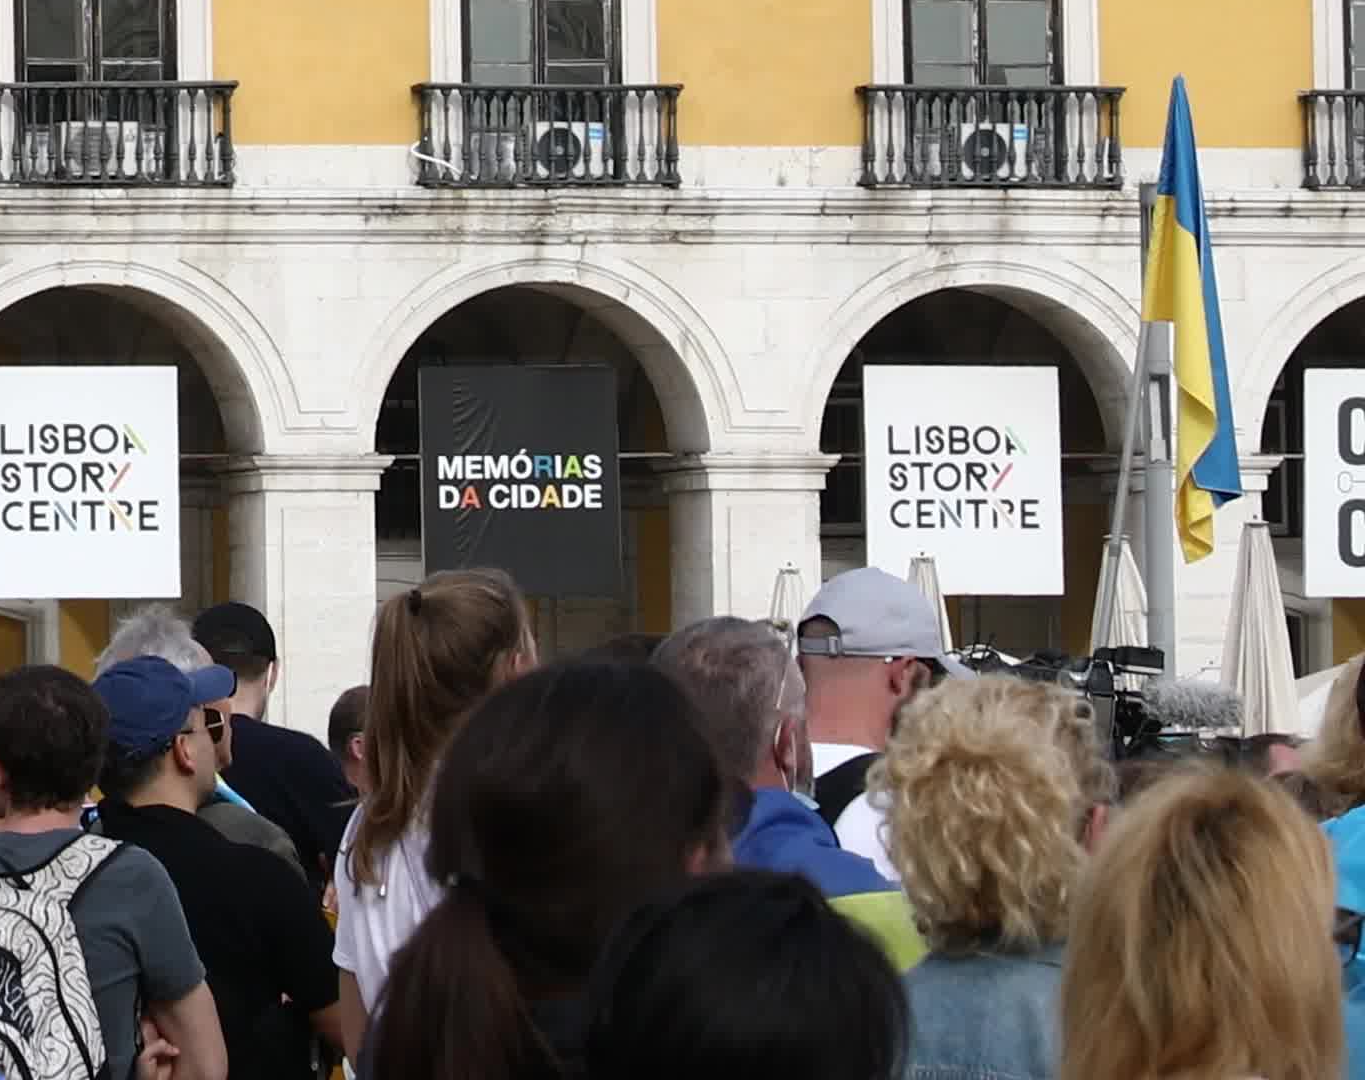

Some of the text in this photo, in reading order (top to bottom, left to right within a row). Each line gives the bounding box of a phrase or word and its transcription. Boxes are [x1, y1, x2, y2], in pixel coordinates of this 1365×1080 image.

[0, 424, 146, 455] LISBOA
[888, 425, 1026, 456] LISBOA
[1, 462, 131, 493] STORY
[437, 449, 602, 480] MEMÓRIAS
[888, 462, 1014, 492] STORY
[439, 484, 603, 509] DA CIDADE
[2, 500, 159, 532] CENTRE
[890, 499, 1040, 529] CENTRE
